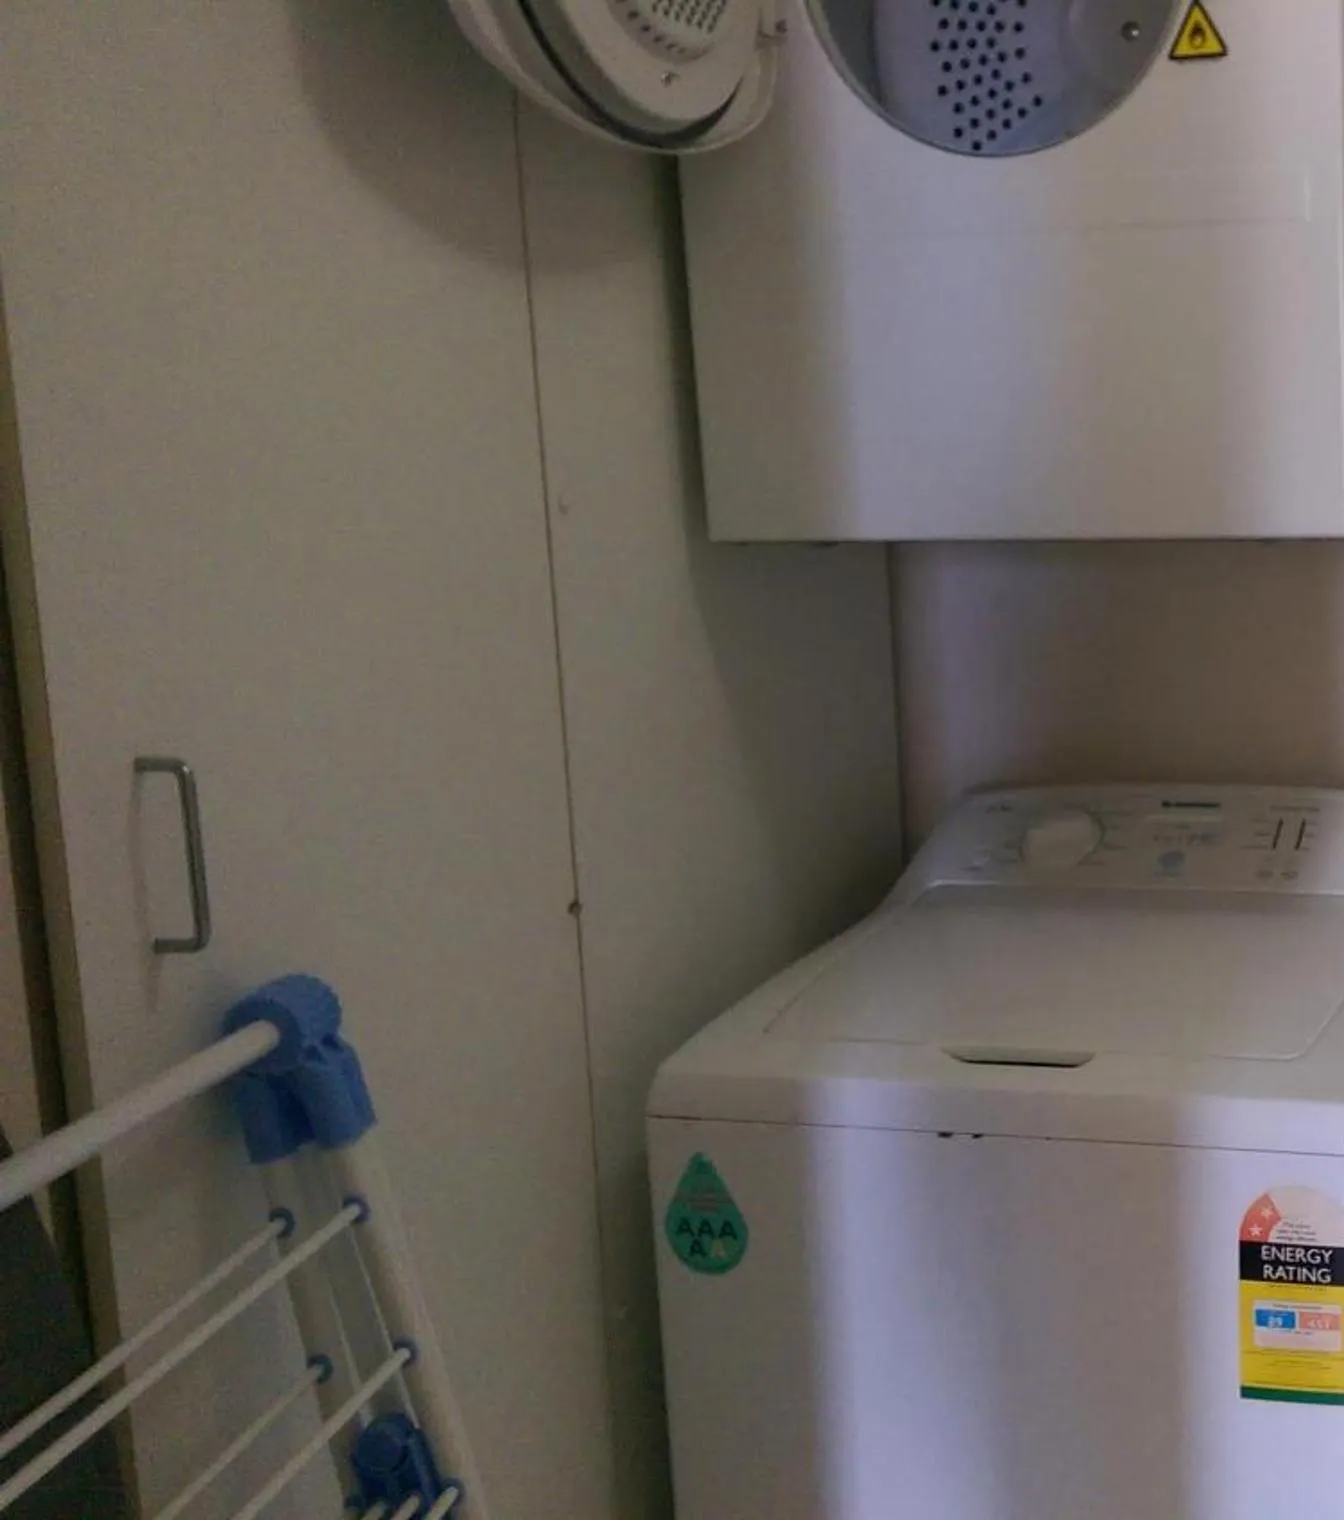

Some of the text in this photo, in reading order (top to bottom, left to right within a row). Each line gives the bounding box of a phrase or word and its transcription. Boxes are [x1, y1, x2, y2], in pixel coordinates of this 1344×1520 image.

[676, 1217, 738, 1241] AAA
[1260, 1245, 1333, 1264] ENERGY
[1262, 1265, 1332, 1283] RATING
